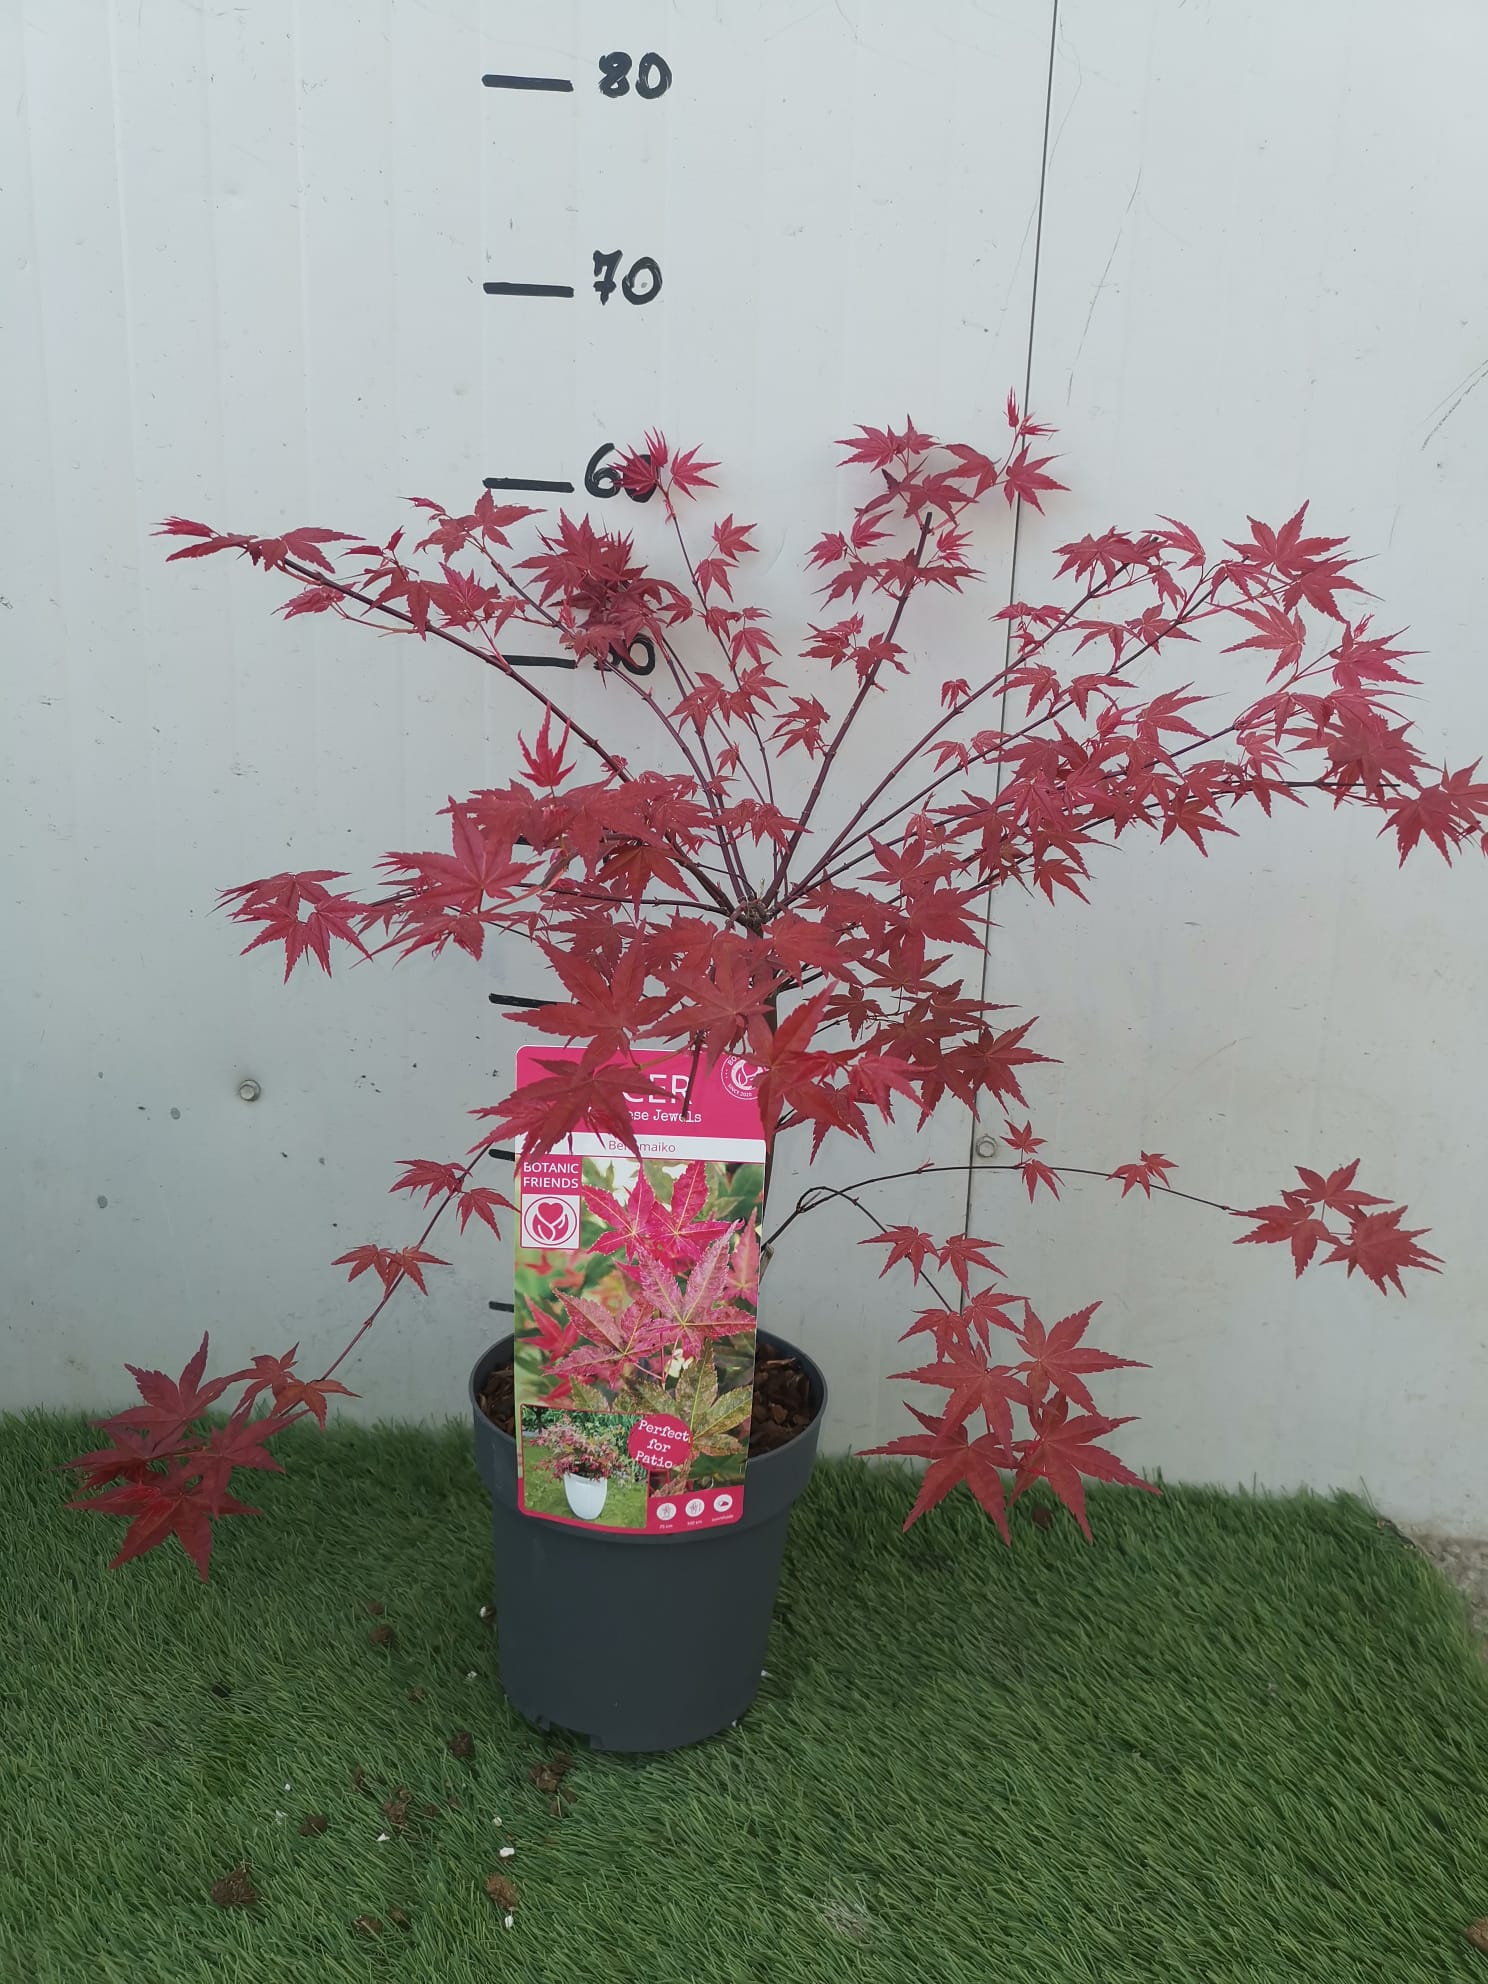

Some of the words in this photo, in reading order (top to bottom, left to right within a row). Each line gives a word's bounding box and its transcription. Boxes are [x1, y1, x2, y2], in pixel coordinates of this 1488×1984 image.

[598, 51, 672, 99] 80
[593, 249, 663, 305] 70
[523, 1162, 579, 1174] BOTANIC
[523, 1176, 579, 1189] FRIENDS
[638, 1420, 690, 1442] Perfect
[647, 1438, 671, 1453] for
[635, 1450, 673, 1469] Patio
